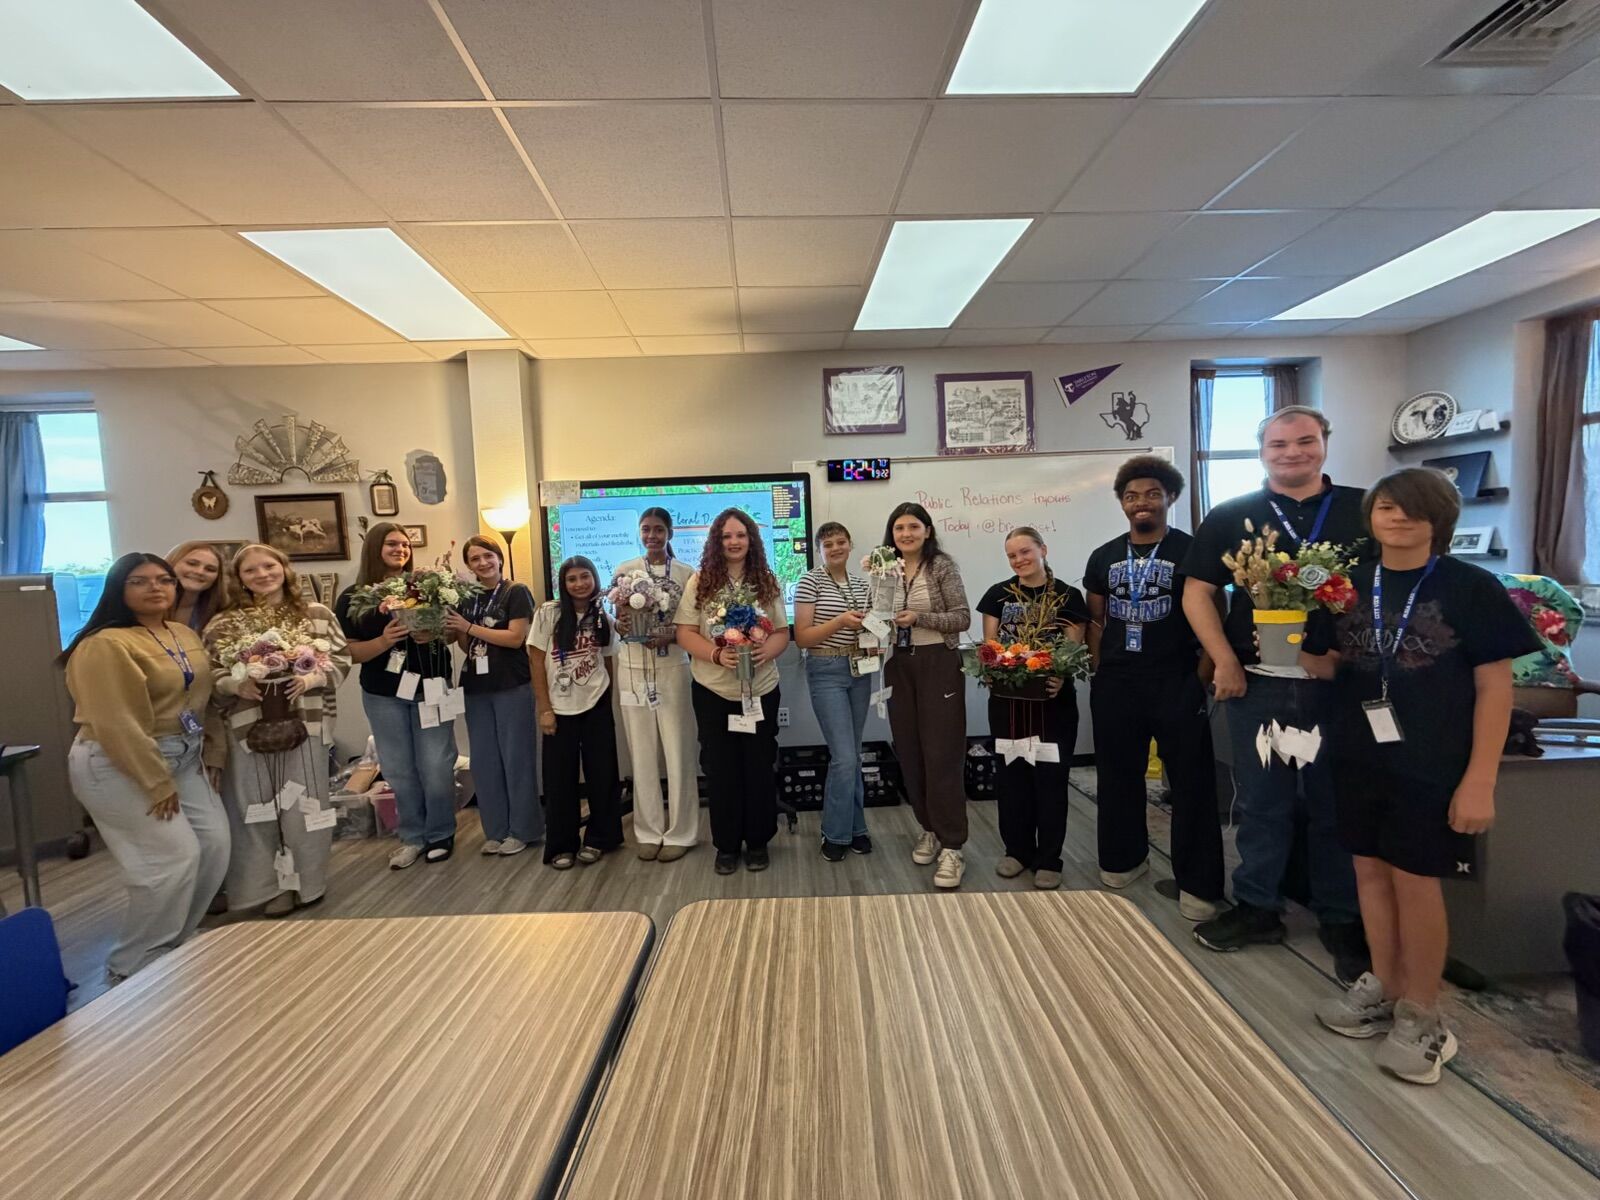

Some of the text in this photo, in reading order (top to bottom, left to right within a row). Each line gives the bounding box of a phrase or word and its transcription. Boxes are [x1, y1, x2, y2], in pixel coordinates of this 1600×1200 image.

[843, 460, 875, 480] 8:24
[915, 486, 1072, 510] Public Relations tryouts
[586, 513, 616, 524] Agenda:
[938, 517, 971, 538] Today
[1108, 562, 1174, 589] STATE
[1109, 594, 1172, 622] BOUND
